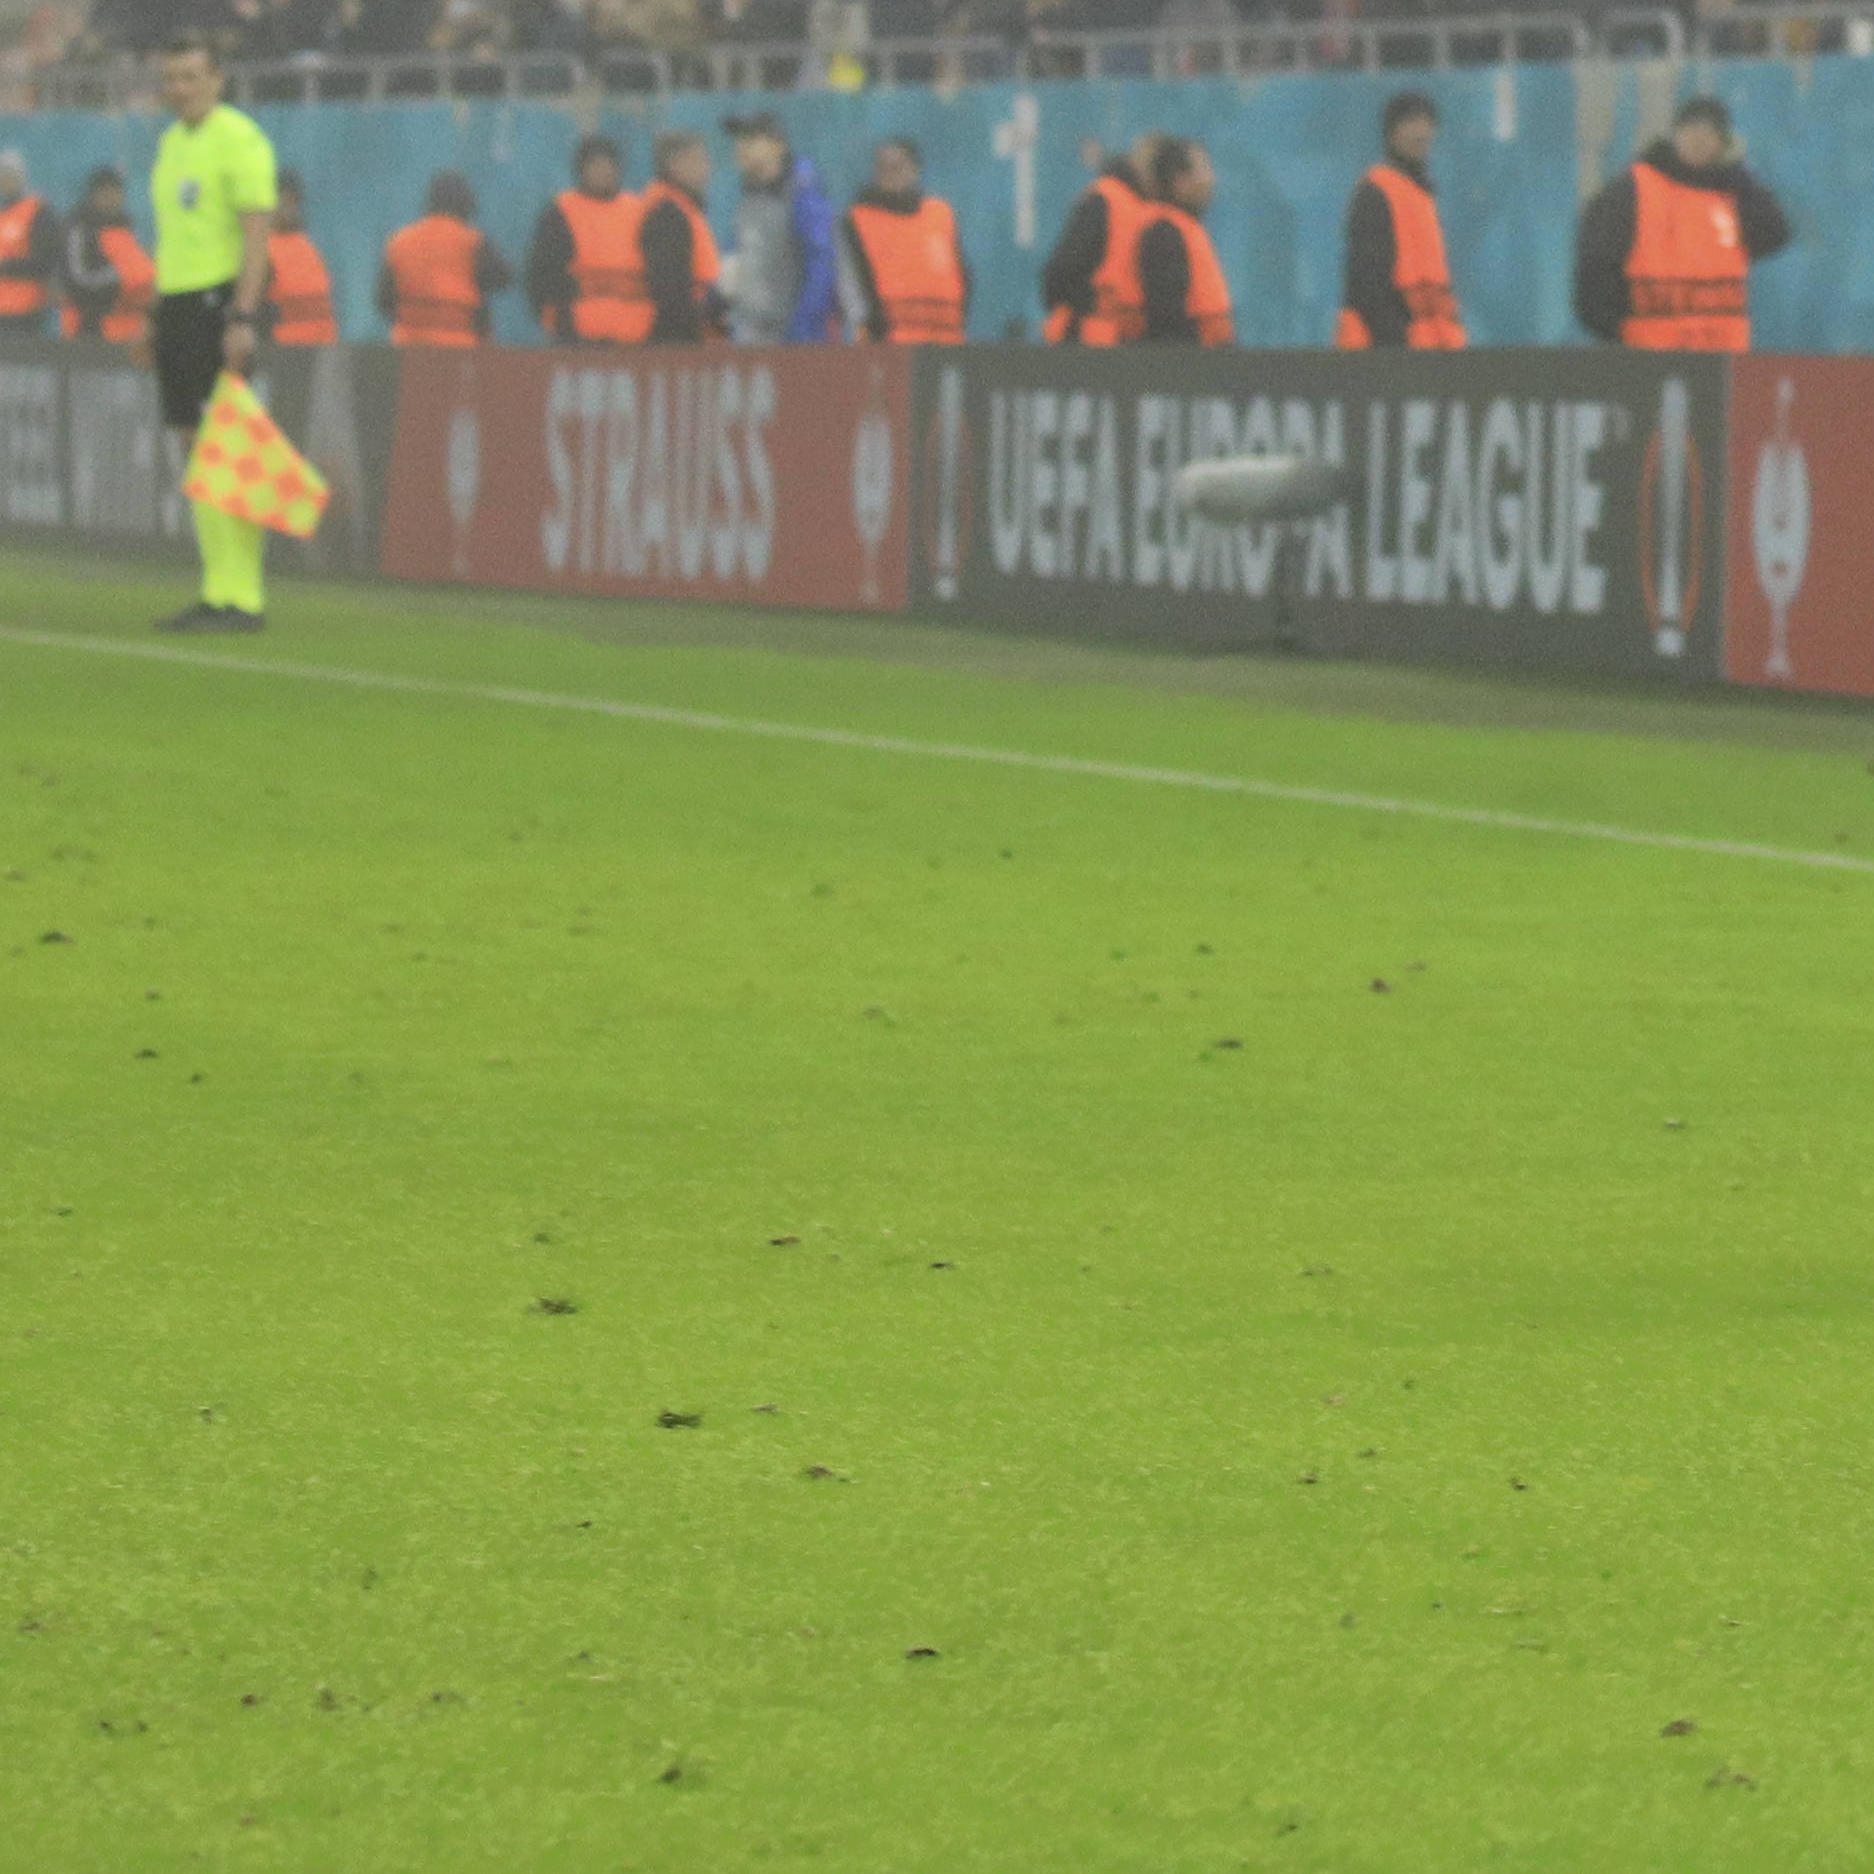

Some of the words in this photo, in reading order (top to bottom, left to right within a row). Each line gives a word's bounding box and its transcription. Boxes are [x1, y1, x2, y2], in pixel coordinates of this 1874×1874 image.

[540, 366, 776, 583] STRAUSS
[990, 389, 1124, 583] UEFA
[1364, 398, 1608, 615] LEAGUE
